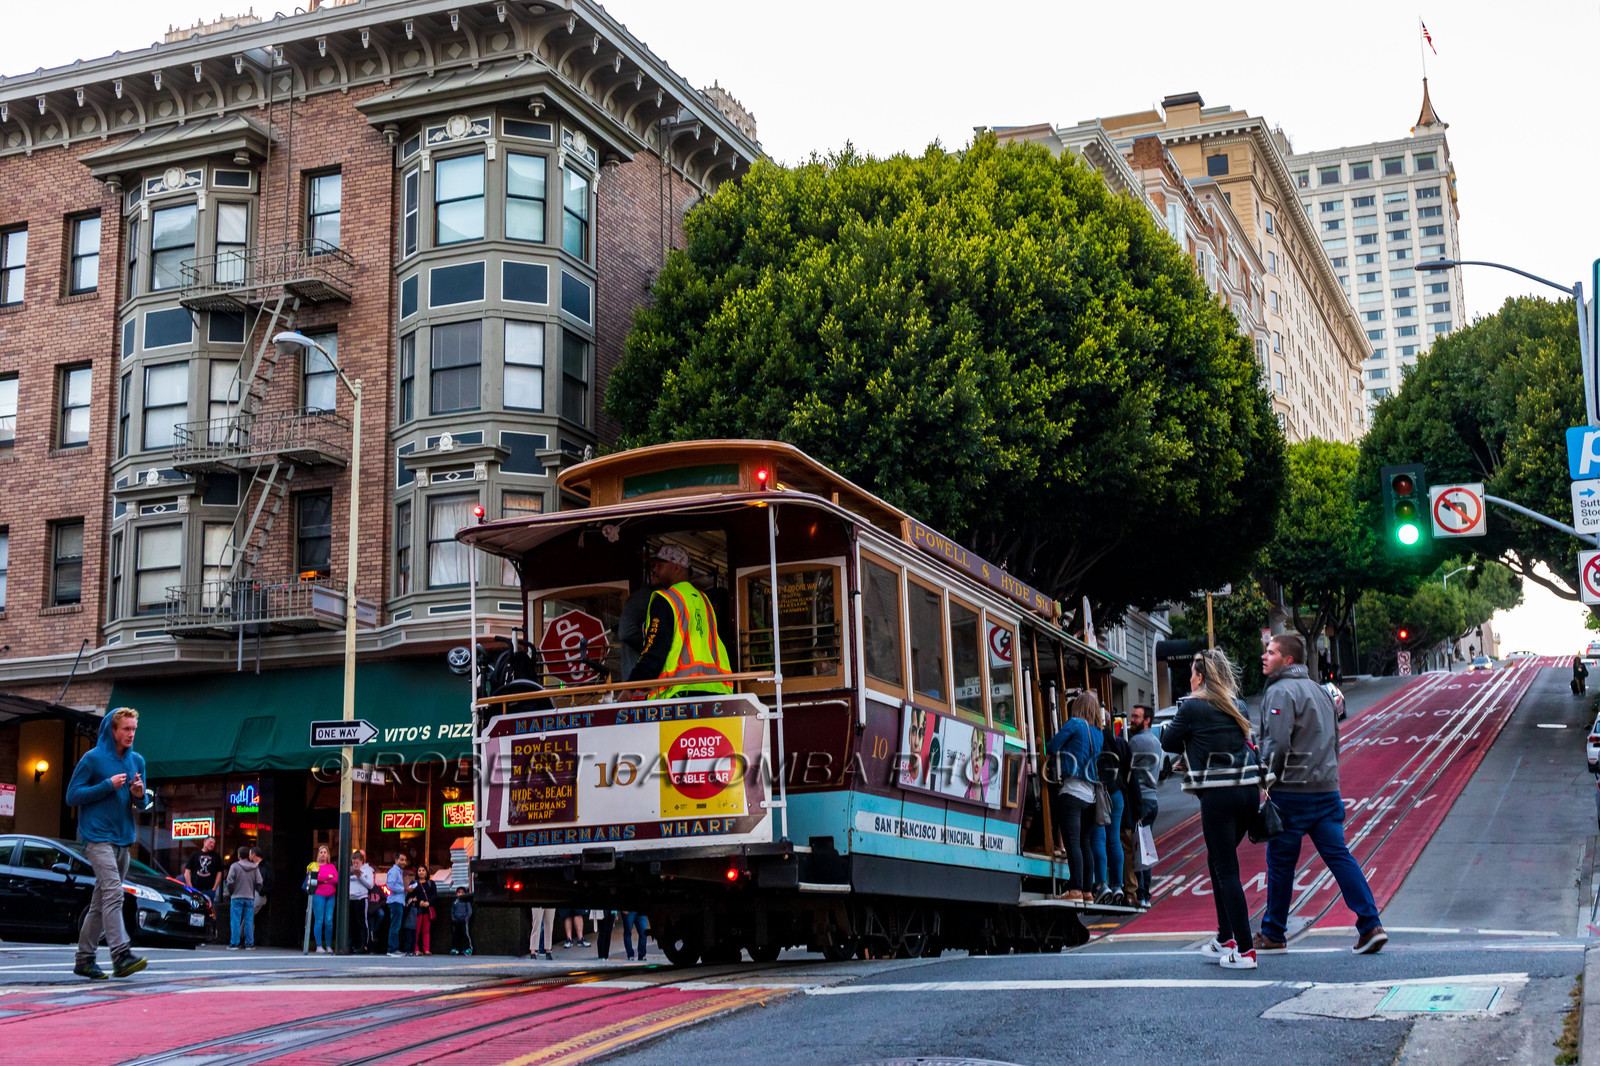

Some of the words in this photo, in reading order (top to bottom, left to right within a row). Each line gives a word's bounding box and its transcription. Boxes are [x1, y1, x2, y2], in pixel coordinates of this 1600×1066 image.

[915, 525, 971, 569] POWELL
[982, 563, 991, 580] &
[1001, 573, 1030, 602] HYDE
[515, 712, 594, 734] MARKET
[615, 703, 703, 724] STREET
[317, 729, 336, 738] ONE
[339, 728, 358, 738] WAY
[384, 725, 432, 743] VITO'S
[438, 723, 474, 739] PIZZ
[514, 740, 573, 756] POWELL
[680, 738, 696, 748] DO
[698, 736, 722, 747] NOT
[872, 736, 888, 760] 10
[687, 747, 715, 758] PASS
[513, 760, 575, 776] MARKET
[594, 761, 638, 788] 10
[674, 773, 706, 784] CABLE
[708, 772, 729, 782] CAR
[512, 788, 532, 801] HYDE
[545, 785, 573, 799] BEACH
[516, 800, 567, 812] FISHERMANS
[384, 814, 424, 828] PIZZA
[527, 810, 554, 820] WHARF
[174, 821, 210, 837] PASTA
[506, 825, 637, 848] FISHERMANS
[659, 818, 736, 837] WHARF
[874, 817, 892, 833] SAN
